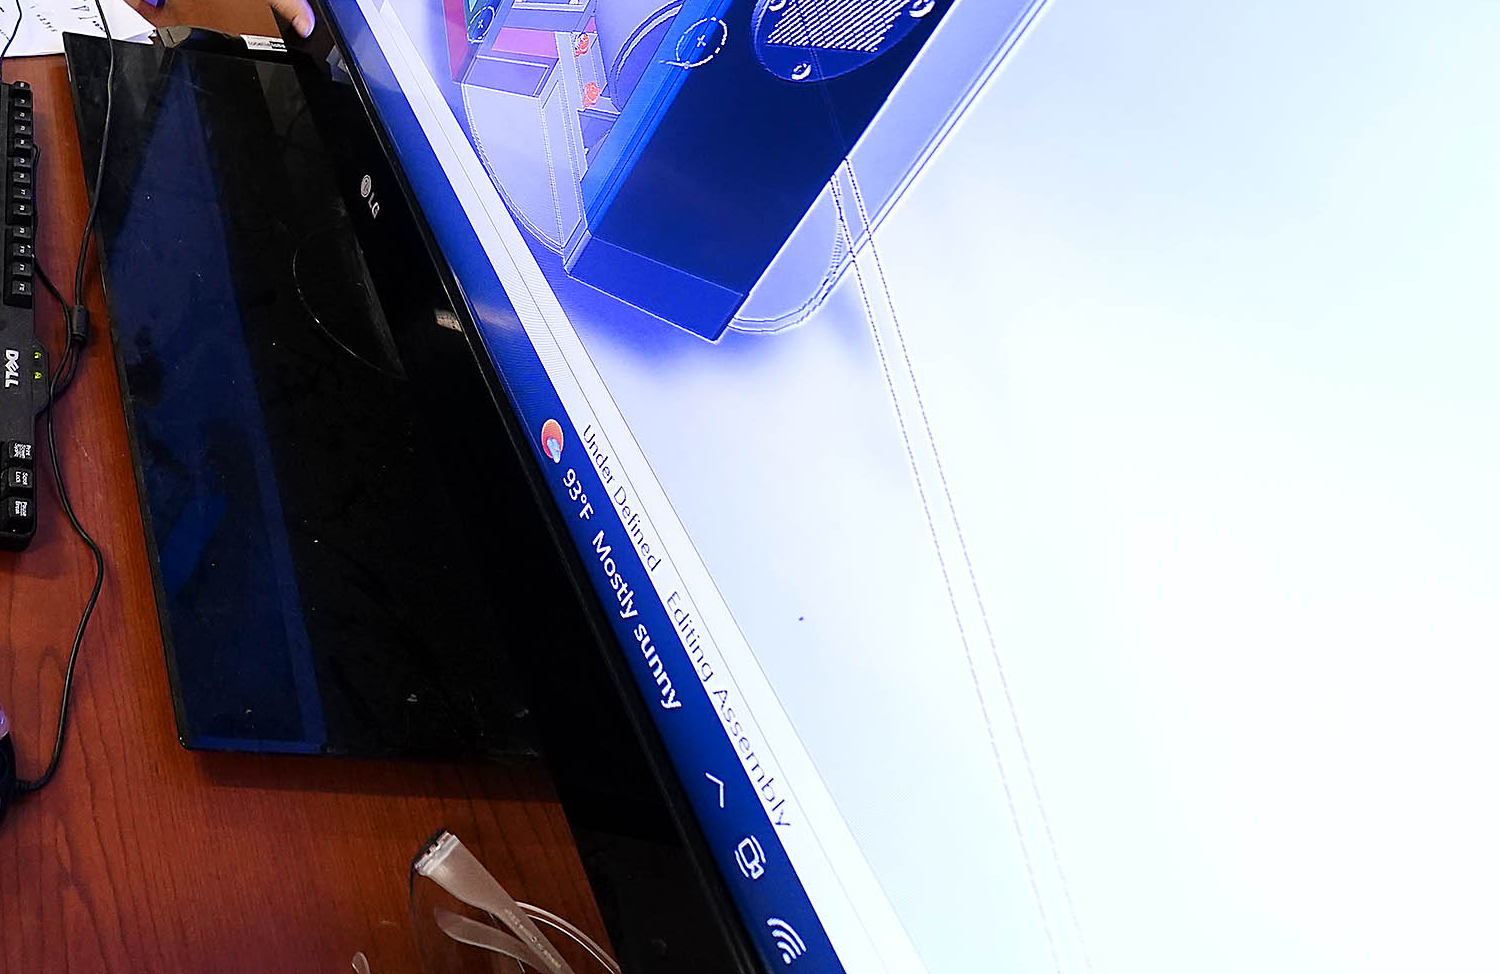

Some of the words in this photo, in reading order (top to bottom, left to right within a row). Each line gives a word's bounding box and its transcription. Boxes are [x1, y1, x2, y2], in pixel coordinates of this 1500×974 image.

[368, 192, 380, 218] LG
[5, 349, 19, 388] DELL
[582, 425, 615, 485] Under
[613, 486, 662, 572] Defined
[562, 468, 595, 520] 93°F
[592, 530, 639, 619] Mostly
[633, 623, 683, 710] sunny
[666, 591, 715, 682] Editing
[713, 689, 791, 827] Assembly
